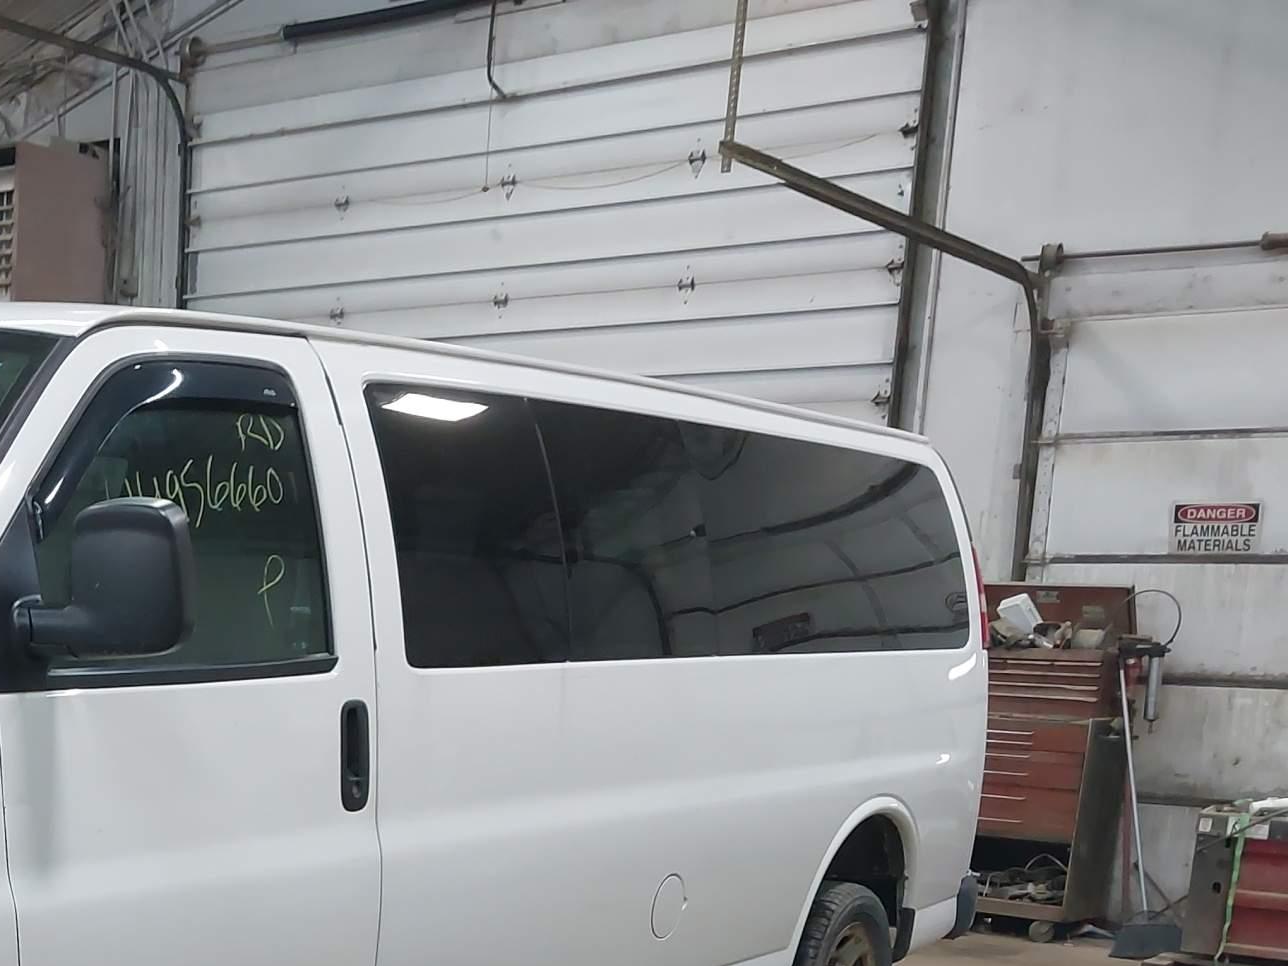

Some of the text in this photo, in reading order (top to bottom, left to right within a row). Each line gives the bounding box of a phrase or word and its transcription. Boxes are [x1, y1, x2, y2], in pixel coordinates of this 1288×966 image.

[1187, 508, 1246, 519] DANGER
[1175, 524, 1256, 537] FLAMMABLE
[1177, 538, 1251, 552] MATERIALS
